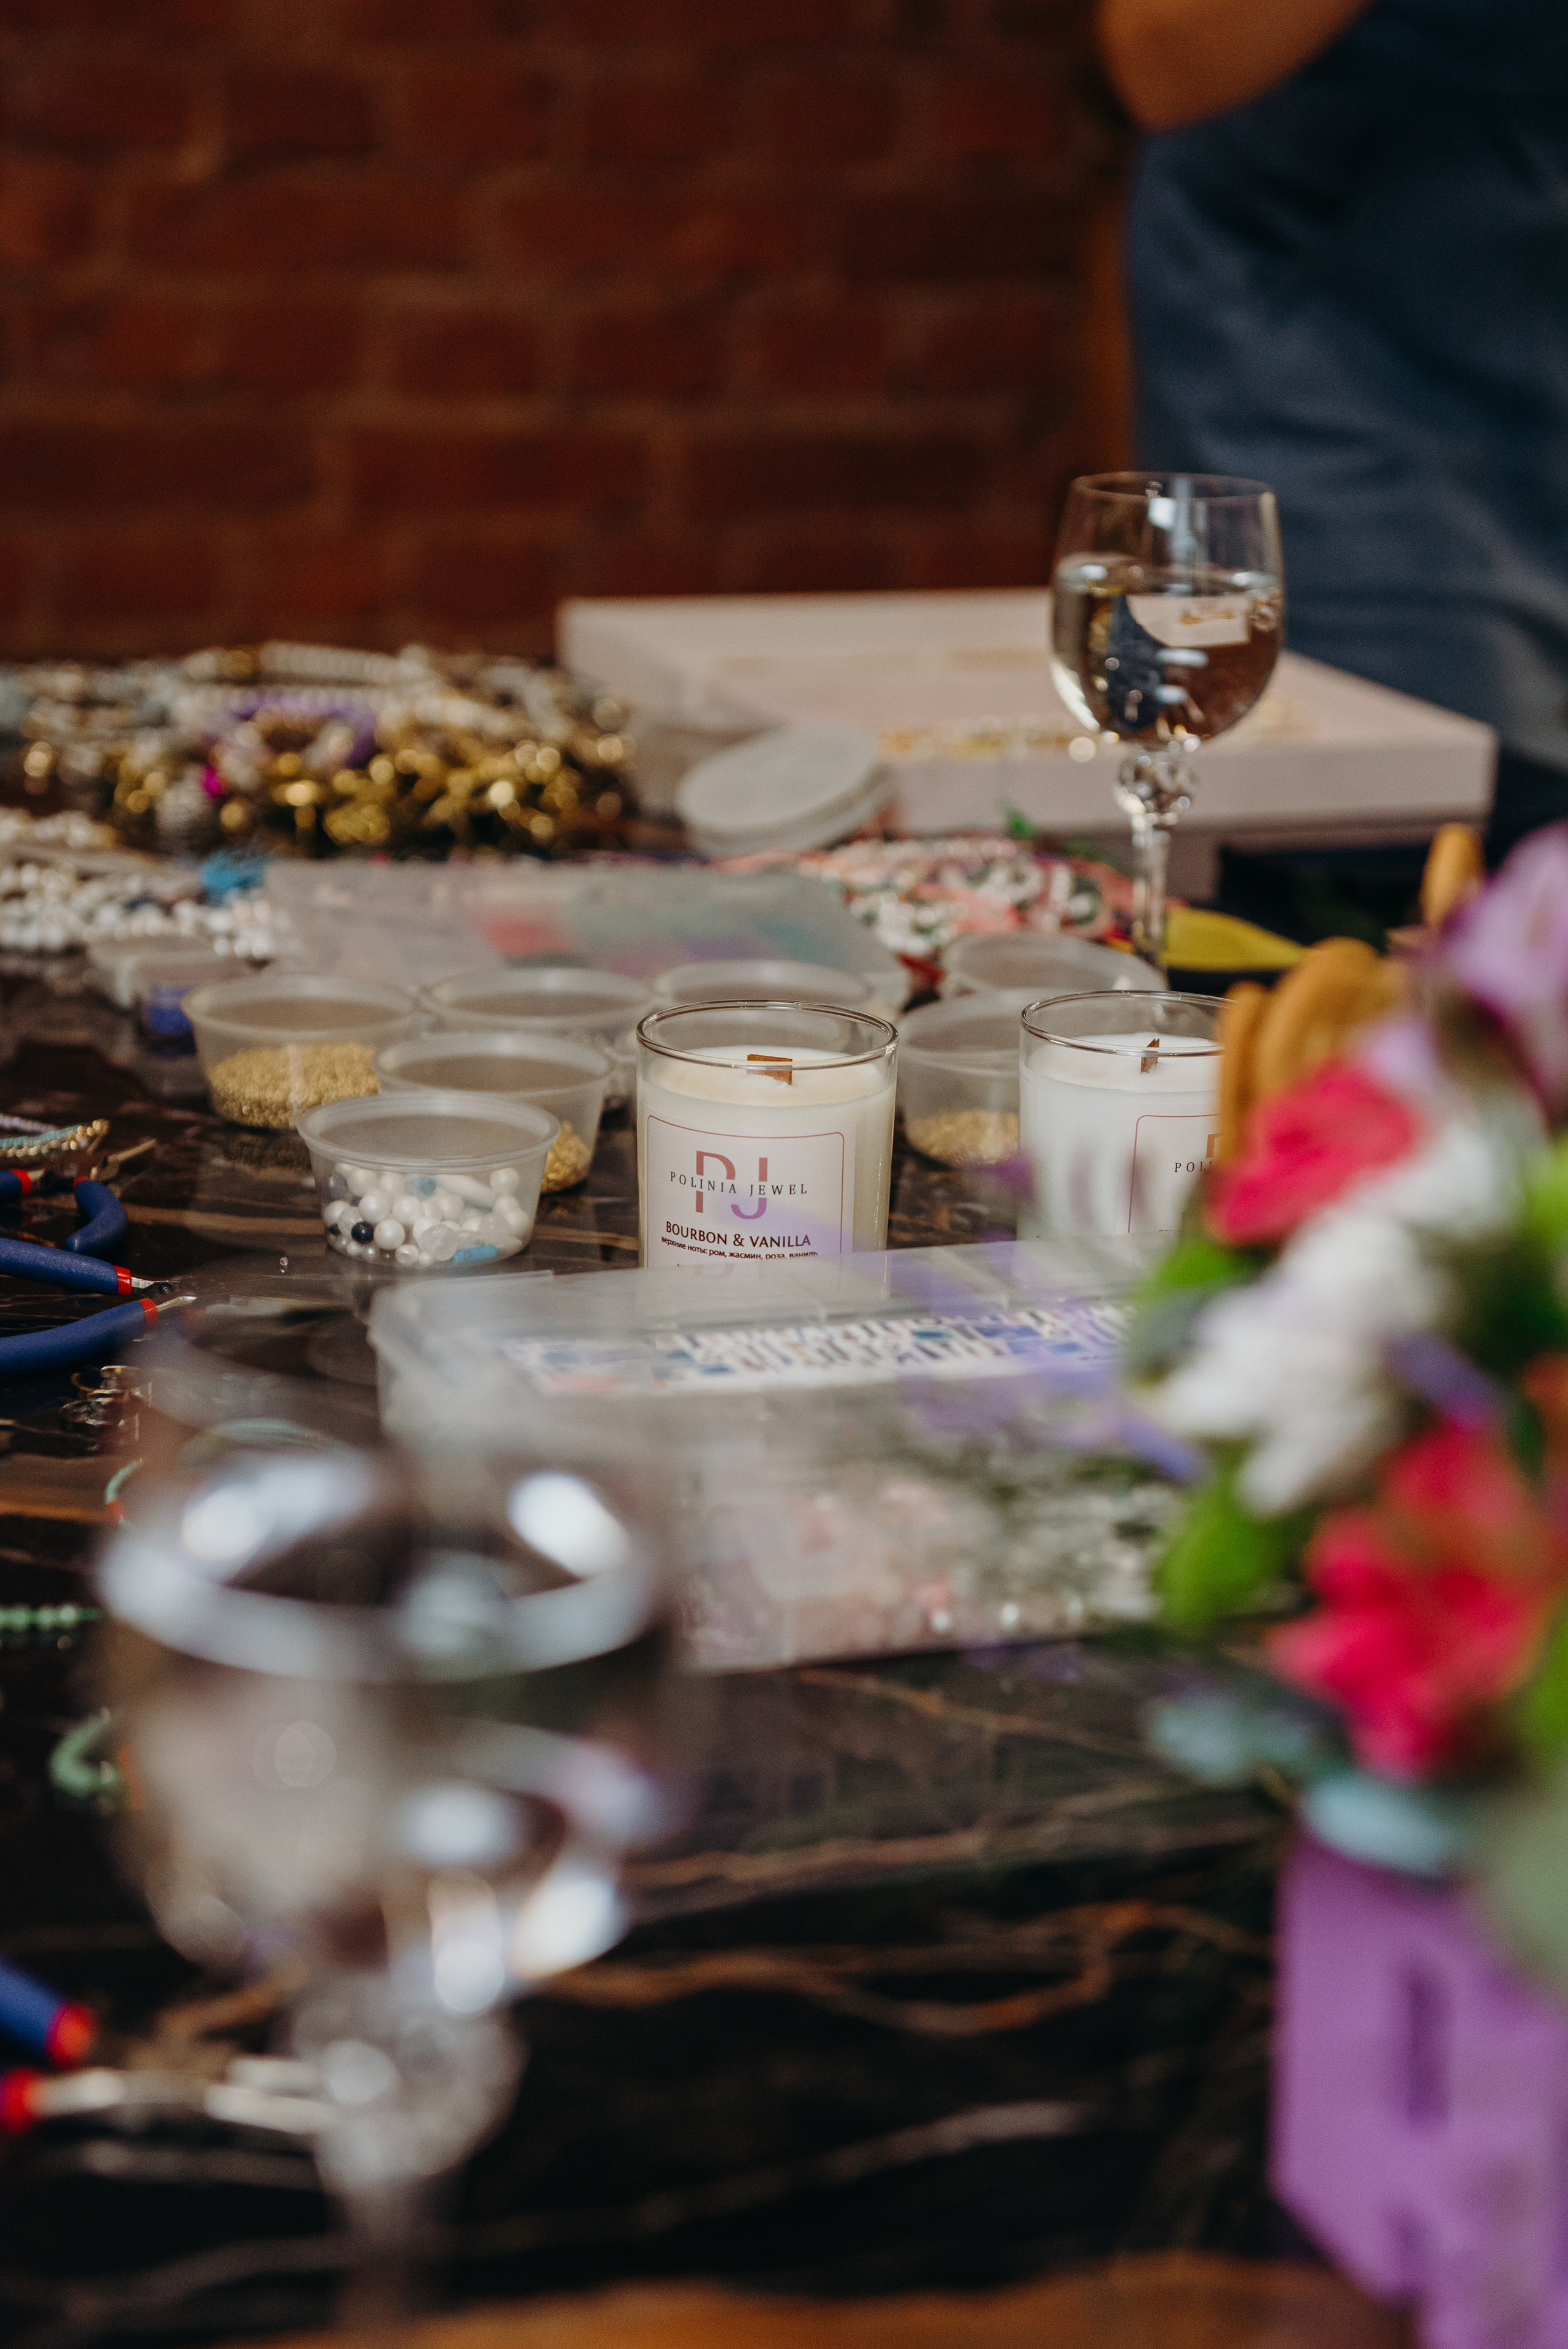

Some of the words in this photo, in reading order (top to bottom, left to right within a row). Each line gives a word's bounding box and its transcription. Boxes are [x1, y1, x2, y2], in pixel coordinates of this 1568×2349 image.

[670, 1171, 737, 1194] POLINIA
[749, 1184, 807, 1197] JEWEL
[666, 1220, 727, 1245] BOURBON
[733, 1233, 745, 1247] &
[749, 1235, 811, 1247] VANILLA
[662, 1236, 686, 1249] верхние
[687, 1245, 707, 1254] ноты:
[709, 1249, 727, 1258] ром,
[728, 1252, 763, 1260] жасмин,
